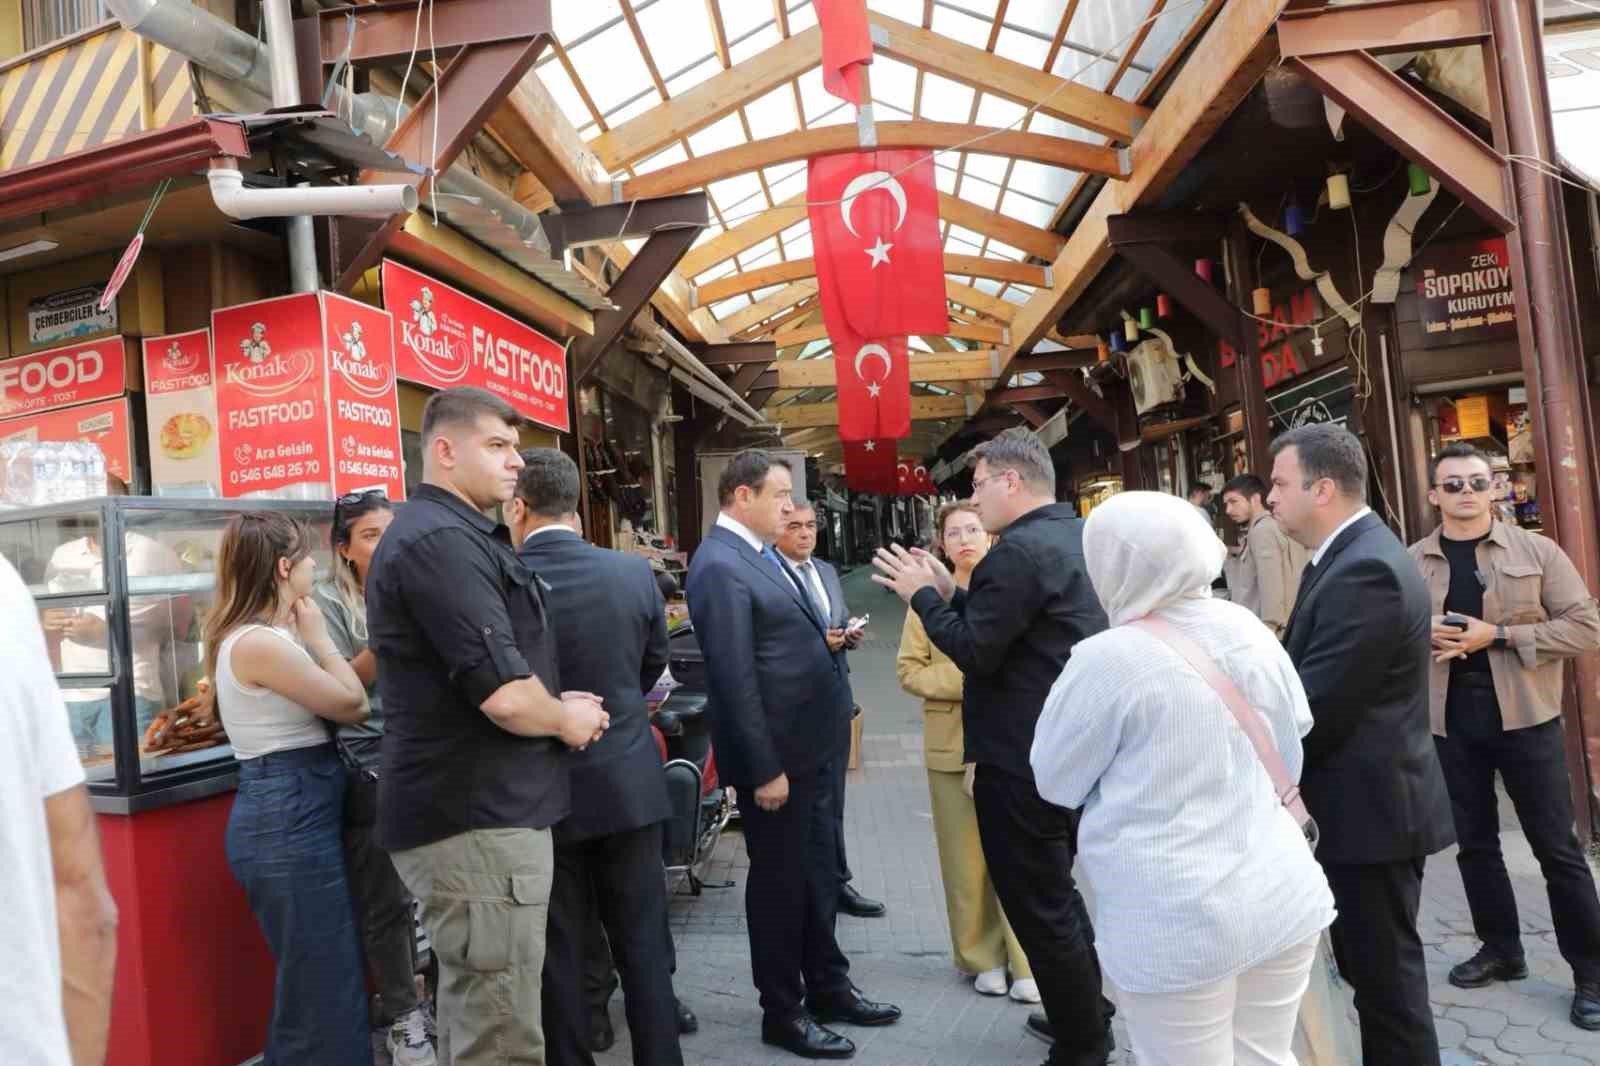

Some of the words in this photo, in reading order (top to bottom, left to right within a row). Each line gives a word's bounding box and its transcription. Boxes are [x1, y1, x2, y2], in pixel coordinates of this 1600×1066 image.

[401, 319, 454, 361] Konak
[223, 353, 290, 384] Konak
[331, 348, 381, 381] Konak
[472, 324, 565, 400] FASTFOOD
[151, 373, 210, 392] FASTFOOD
[228, 399, 315, 430] FASTFOOD
[337, 399, 393, 428] FASTFOOD
[255, 447, 276, 461] Ara
[277, 441, 313, 458] Gelsin
[357, 443, 371, 456] Ara
[372, 445, 394, 460] Gelsin
[230, 470, 239, 484] 0
[305, 460, 320, 475] 70
